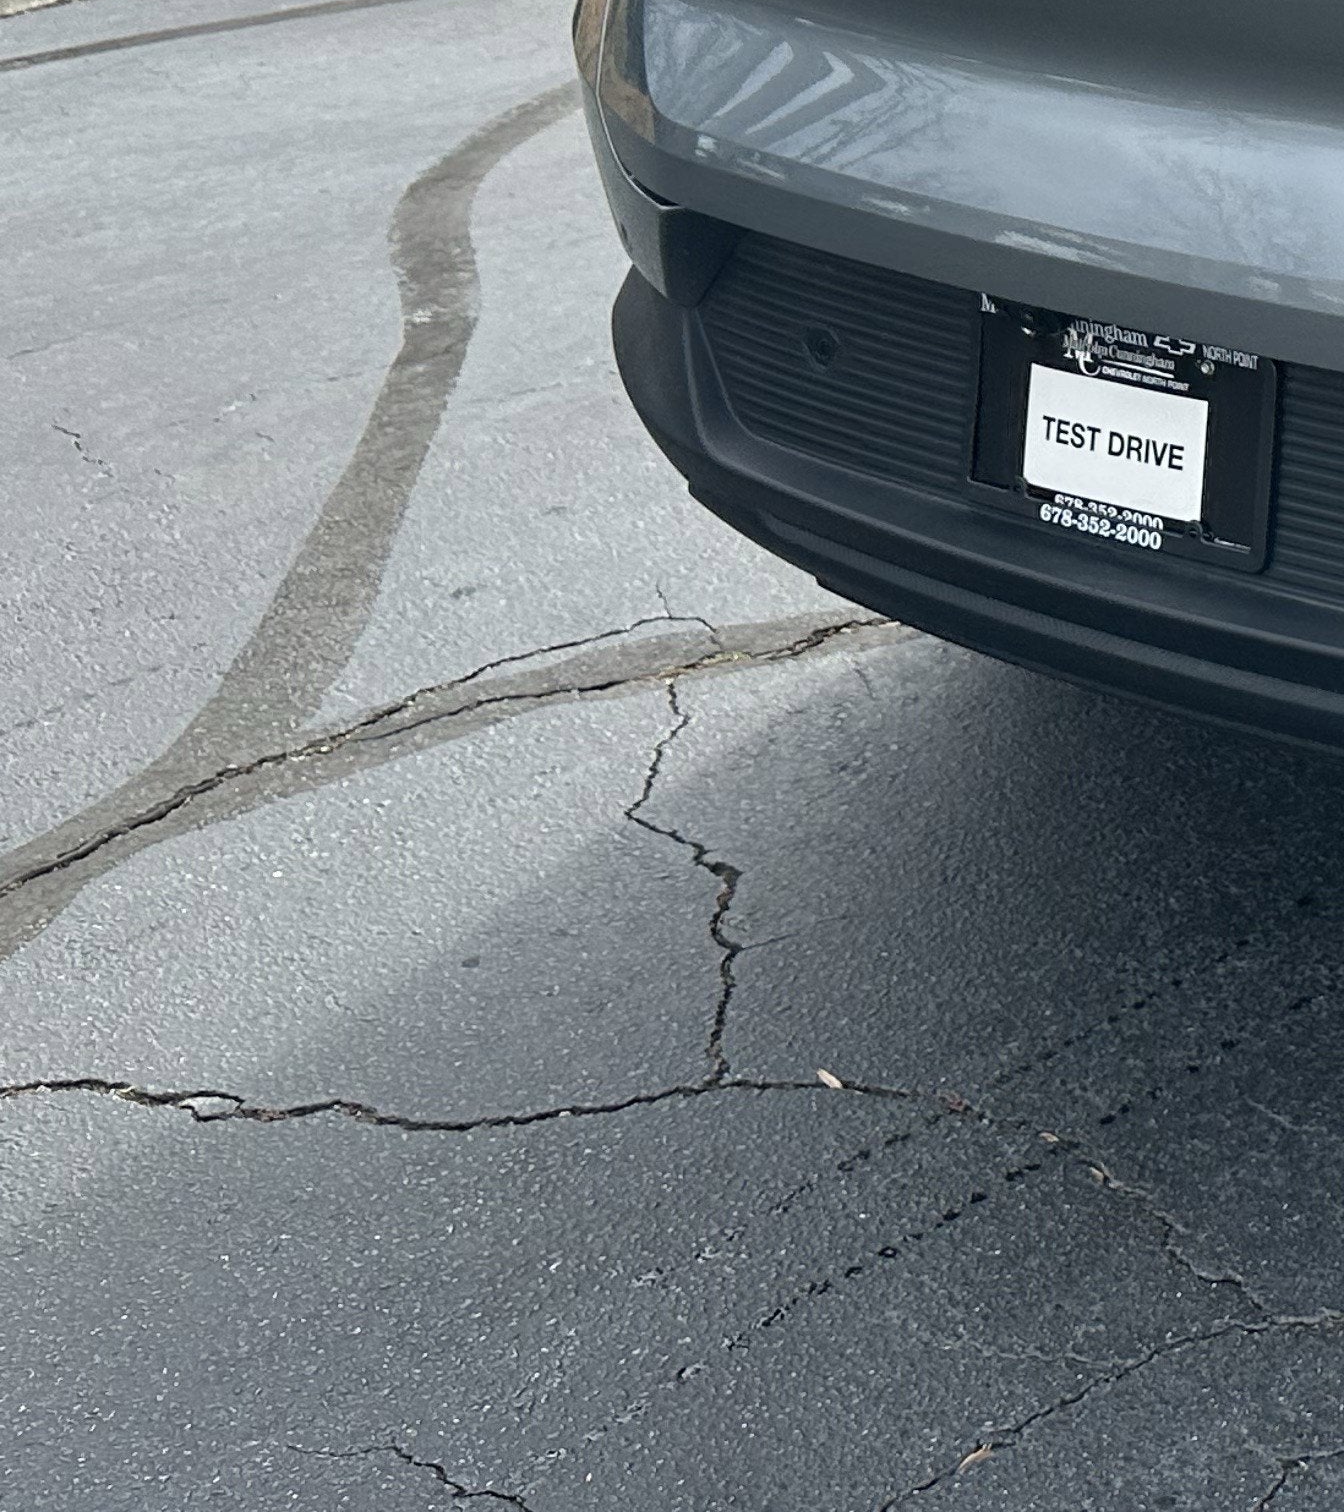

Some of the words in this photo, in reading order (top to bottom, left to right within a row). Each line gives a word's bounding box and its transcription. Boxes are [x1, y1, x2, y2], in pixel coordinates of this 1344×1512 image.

[1233, 352, 1259, 370] POINT
[1043, 415, 1102, 452] TEST
[1107, 431, 1185, 471] DRIVE
[1040, 503, 1163, 550] 678-352-2000
